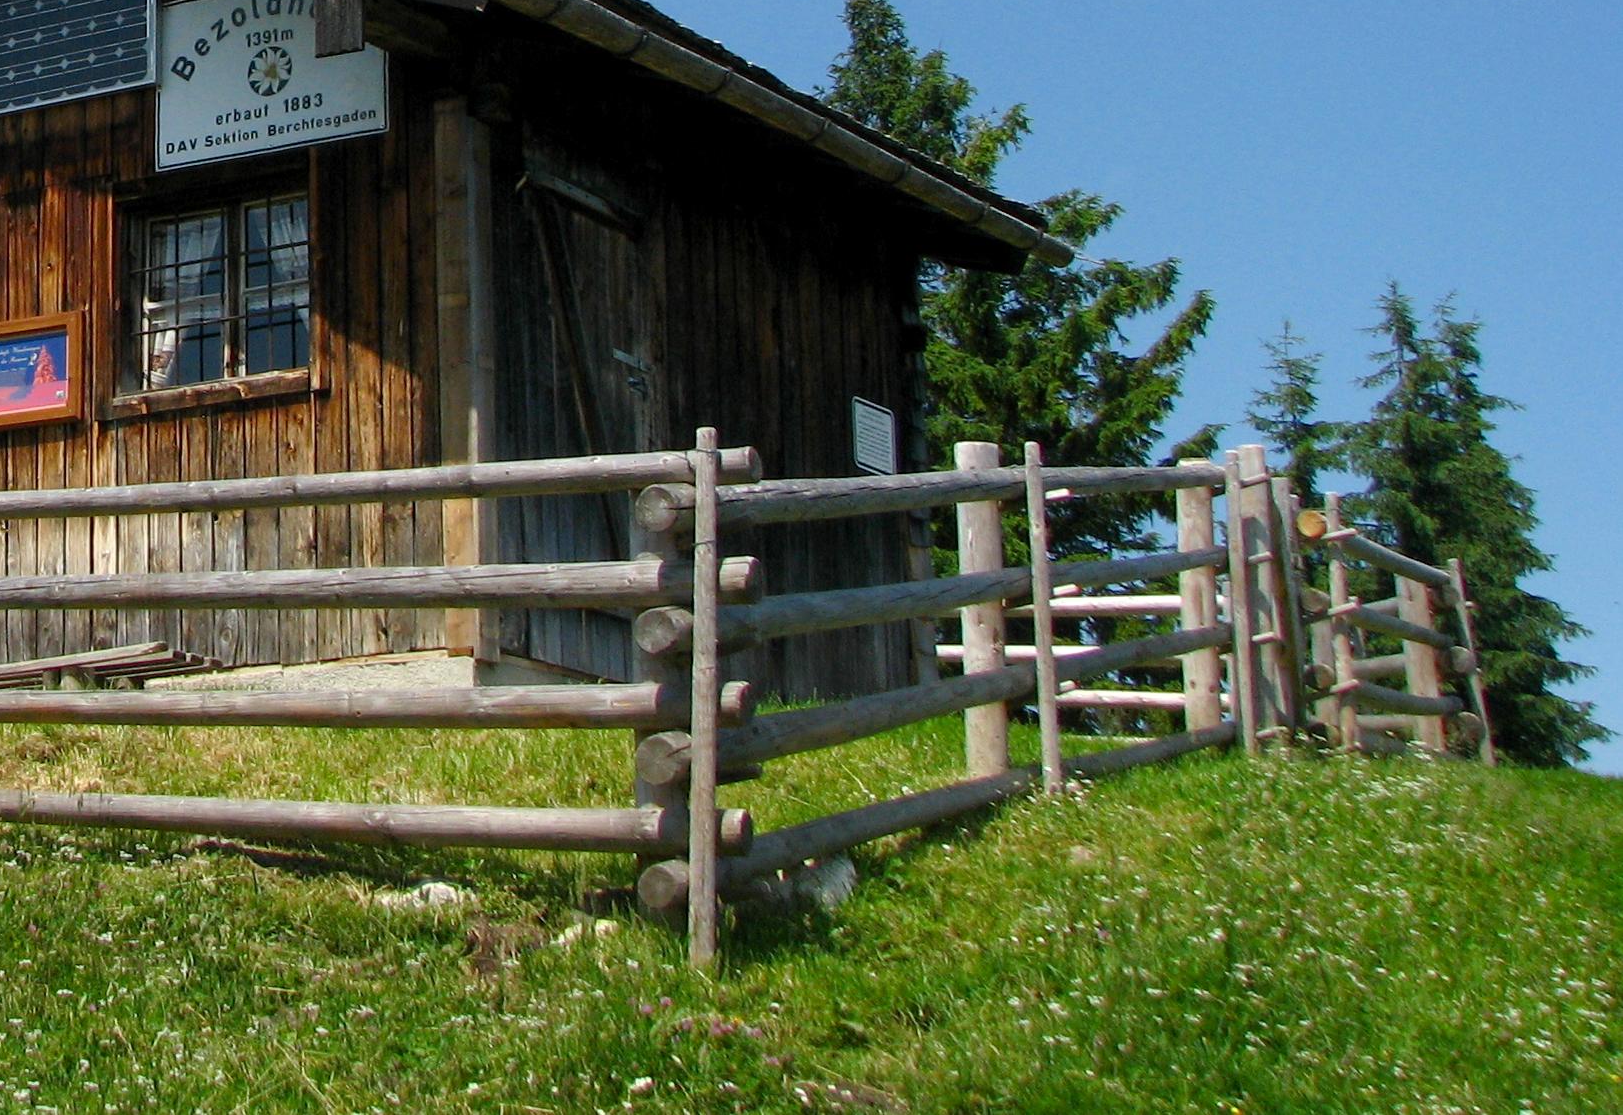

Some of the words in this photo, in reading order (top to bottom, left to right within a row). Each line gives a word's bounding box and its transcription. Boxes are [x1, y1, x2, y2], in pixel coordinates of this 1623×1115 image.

[215, 104, 269, 125] erbaut
[283, 93, 323, 113] 1883
[166, 138, 198, 155] DAV
[204, 130, 259, 147] Sektion
[267, 109, 377, 136] Berchtesgaden
